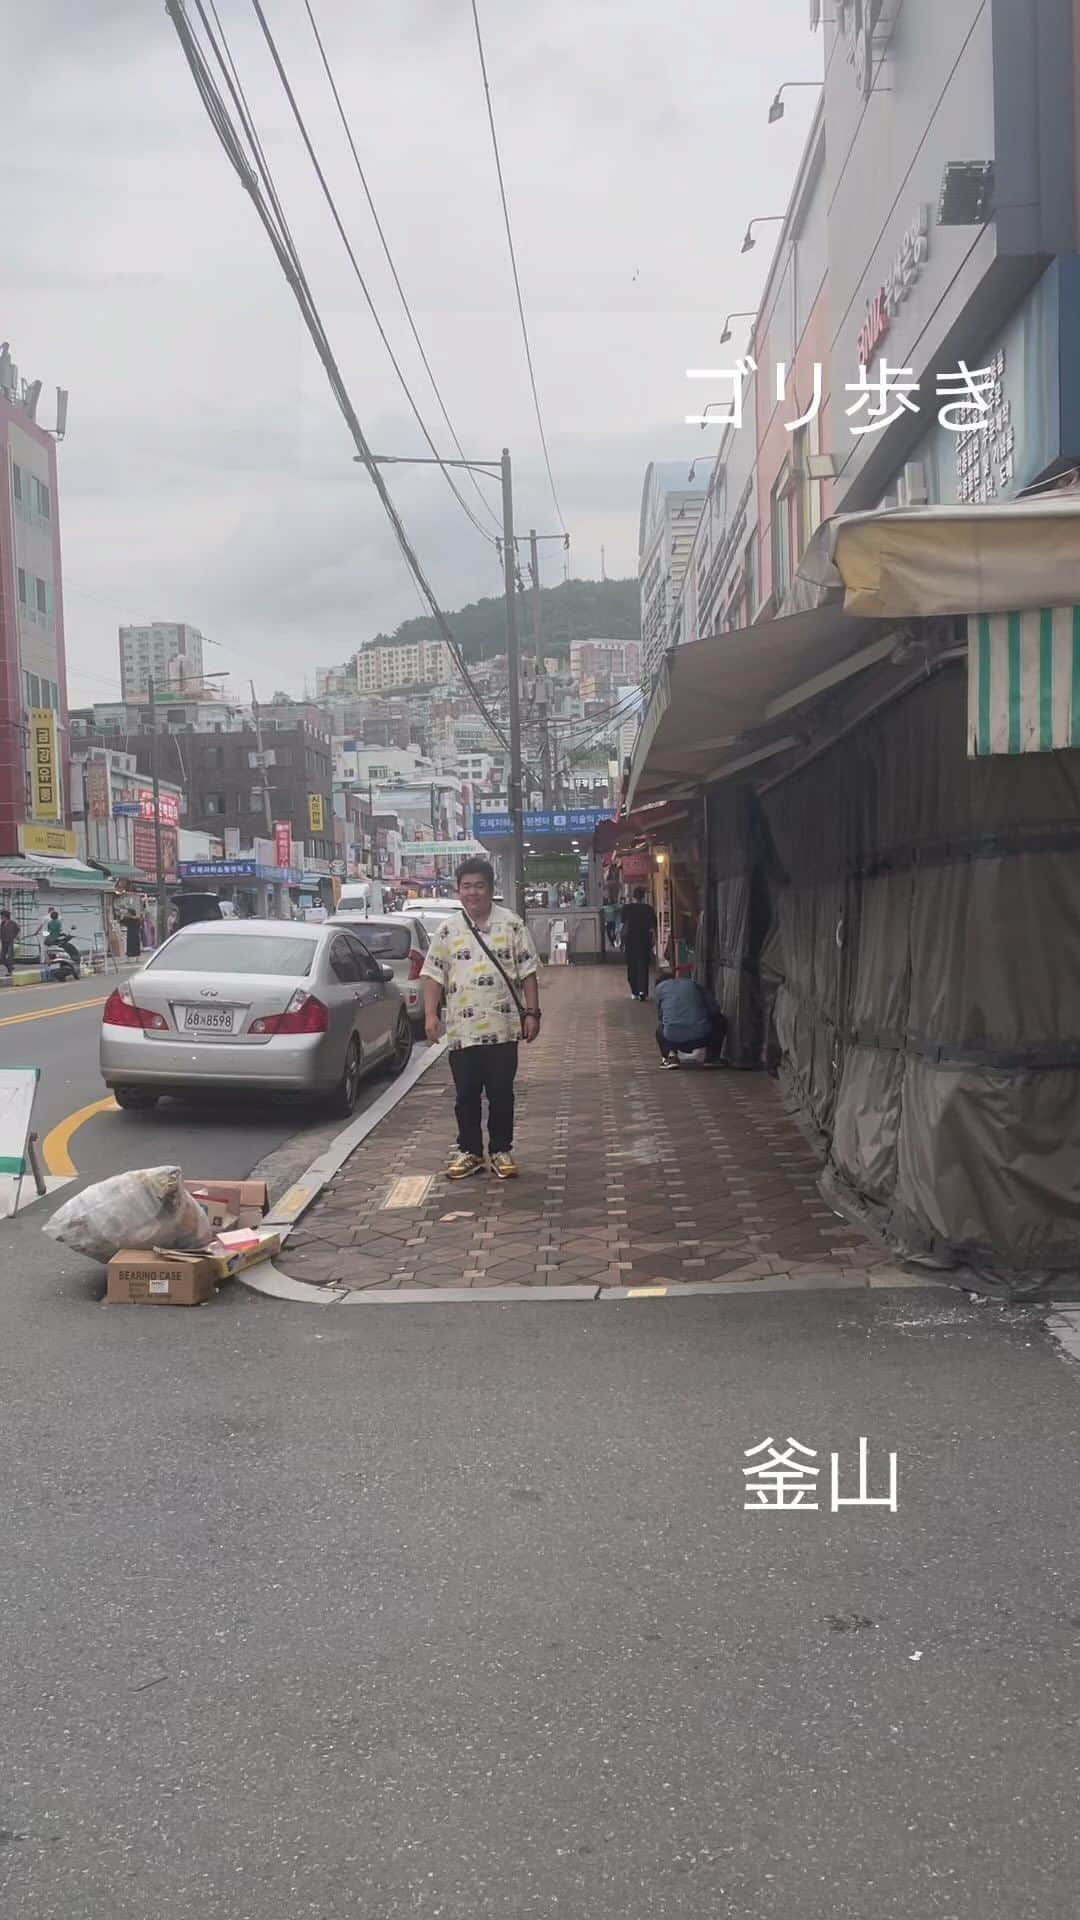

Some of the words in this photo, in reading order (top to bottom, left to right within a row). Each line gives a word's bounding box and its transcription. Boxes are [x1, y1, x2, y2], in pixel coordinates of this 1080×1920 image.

[884, 203, 929, 317] 부산은행
[119, 1270, 157, 1281] BEARING
[159, 1271, 182, 1281] CASE
